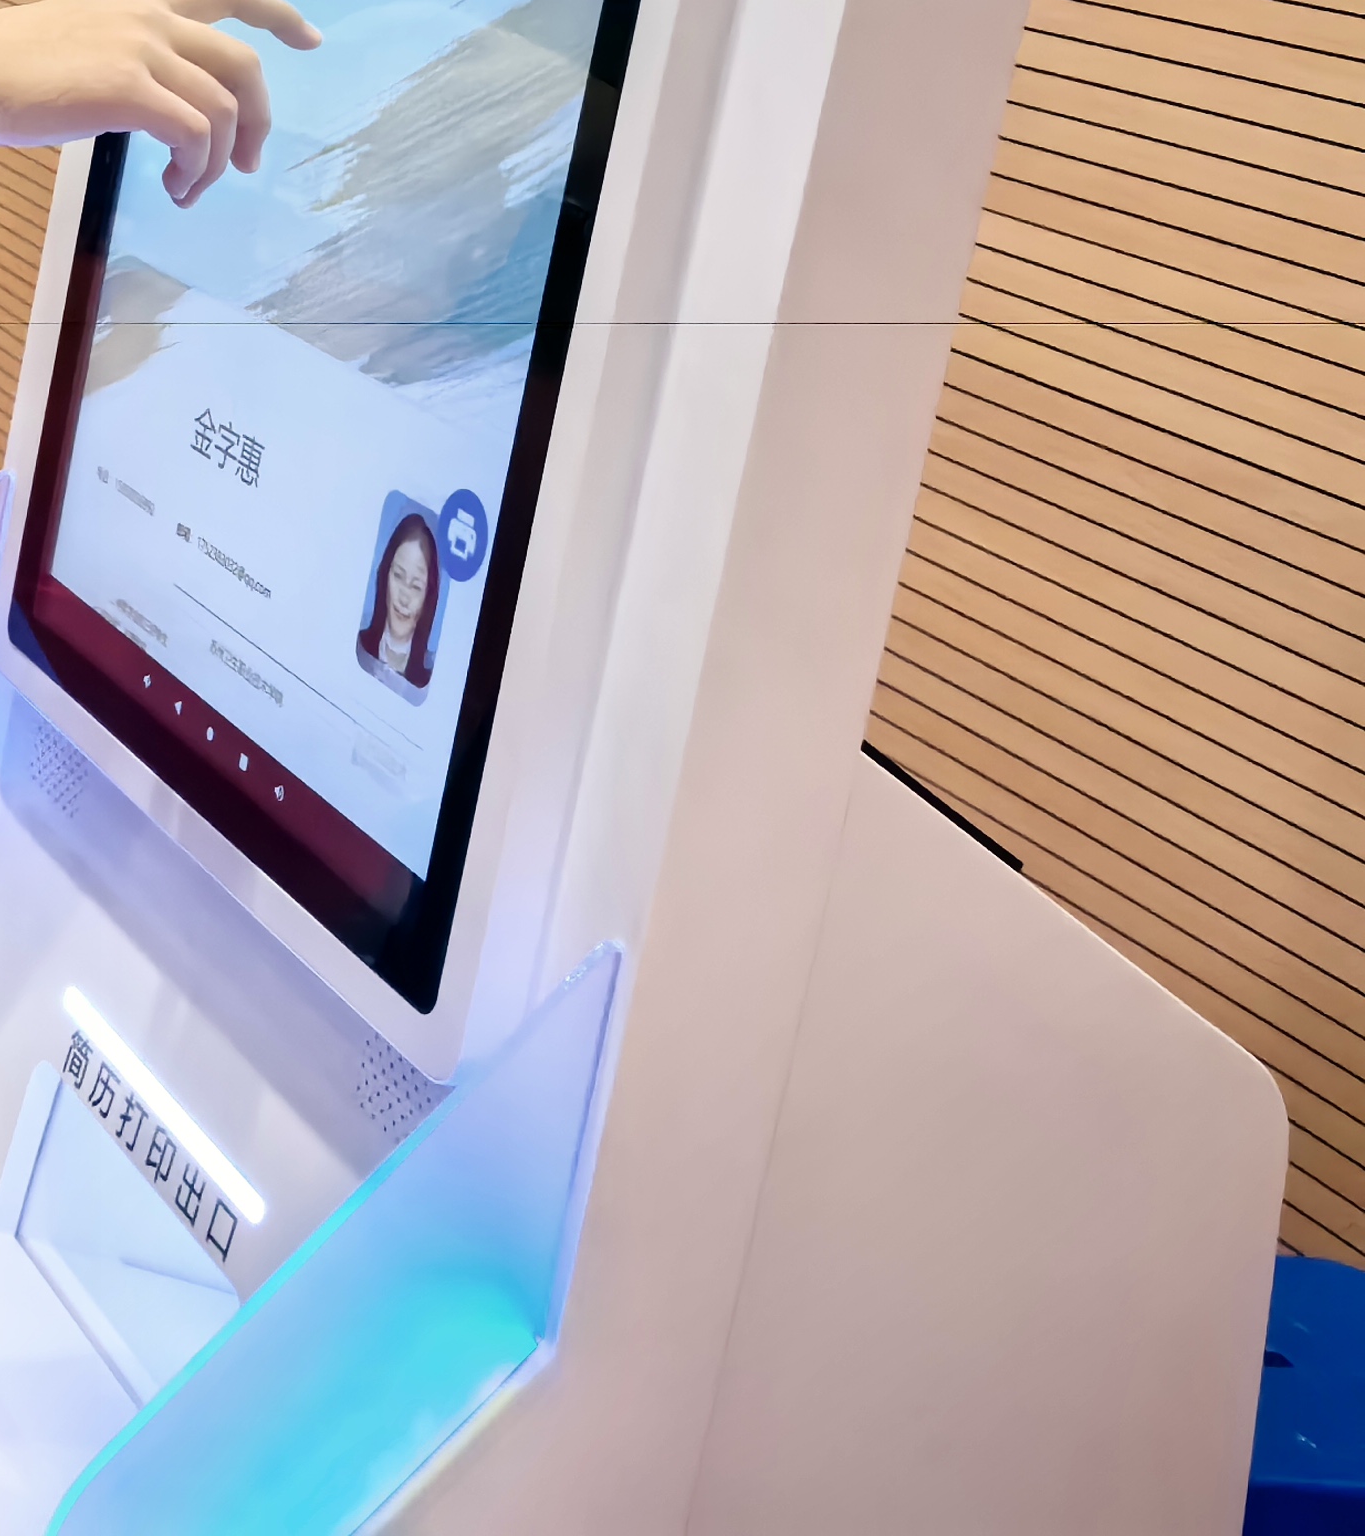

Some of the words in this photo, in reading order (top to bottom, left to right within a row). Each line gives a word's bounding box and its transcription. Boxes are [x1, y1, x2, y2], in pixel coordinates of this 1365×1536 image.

[190, 408, 266, 488] 金字惠
[62, 1030, 239, 1263] 简历打印出口
